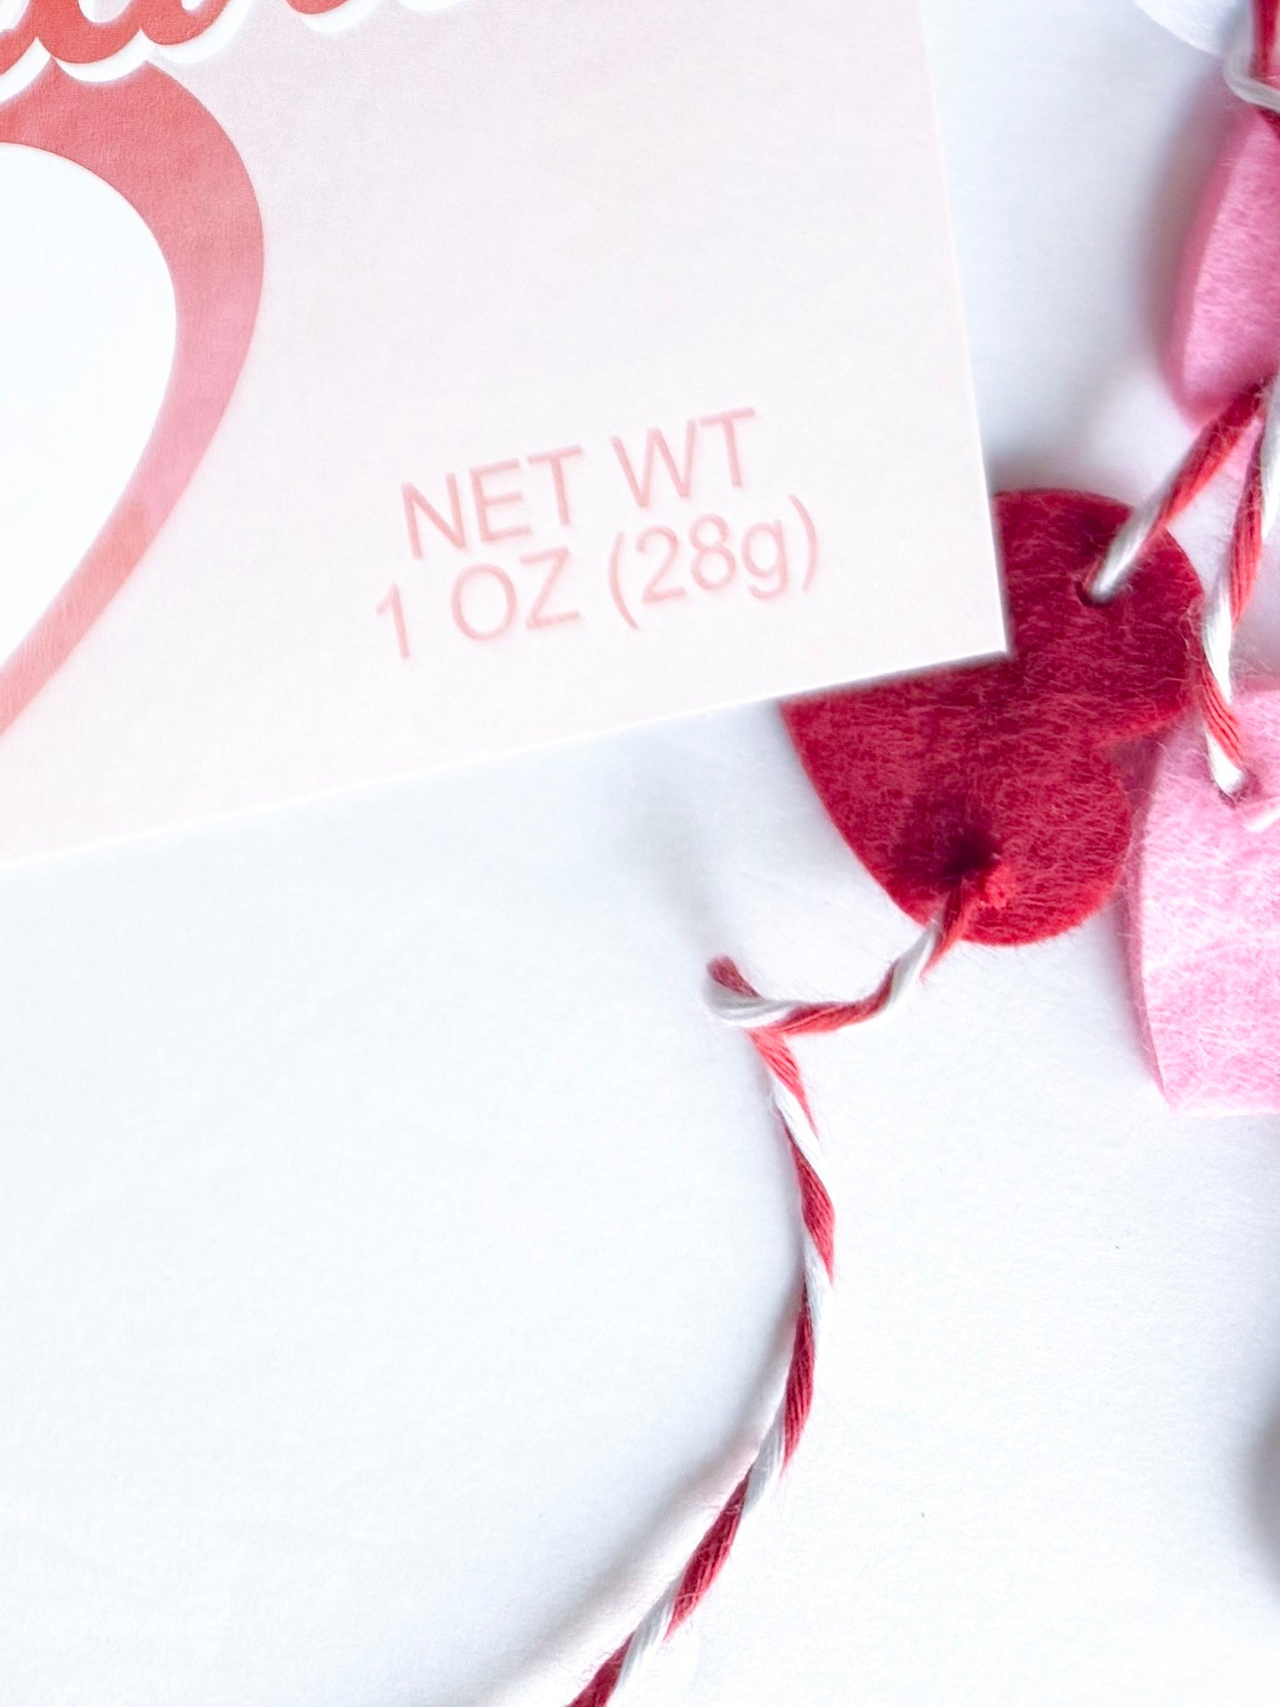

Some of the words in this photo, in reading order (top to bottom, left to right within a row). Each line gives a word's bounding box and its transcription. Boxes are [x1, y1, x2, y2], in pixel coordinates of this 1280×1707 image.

[400, 444, 583, 560] NET
[610, 406, 756, 508] WT
[375, 583, 411, 661] 1
[450, 546, 581, 643] OZ
[608, 493, 819, 631] (28g)
